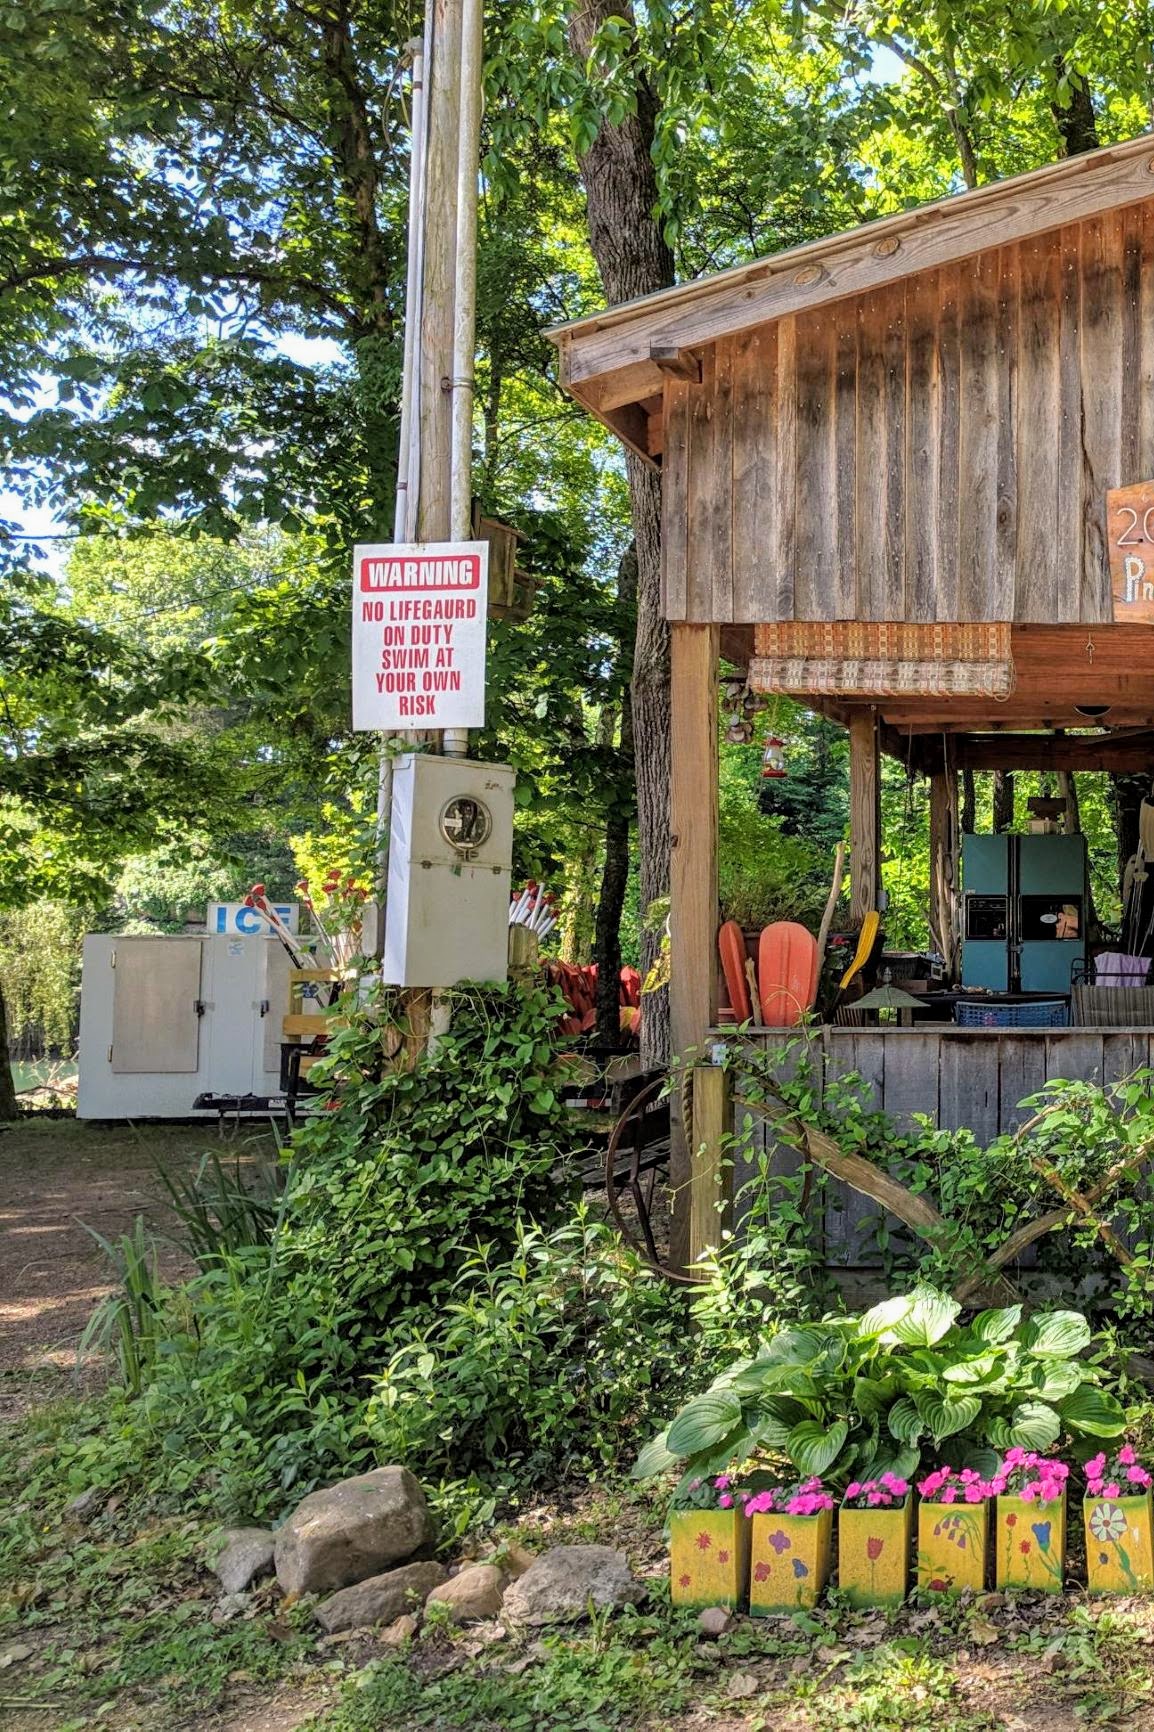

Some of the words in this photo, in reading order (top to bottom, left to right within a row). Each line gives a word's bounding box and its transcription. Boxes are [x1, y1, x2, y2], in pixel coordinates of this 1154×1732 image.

[368, 560, 473, 588] WARNING
[362, 601, 384, 622] NO
[390, 598, 476, 621] LIFEGAURD
[384, 625, 404, 647] ON
[411, 624, 453, 645] DUTY
[382, 648, 428, 670] SWIM
[435, 647, 454, 668] AT
[376, 672, 416, 693] YOUR
[422, 671, 461, 692] OWN
[399, 695, 436, 716] RISK
